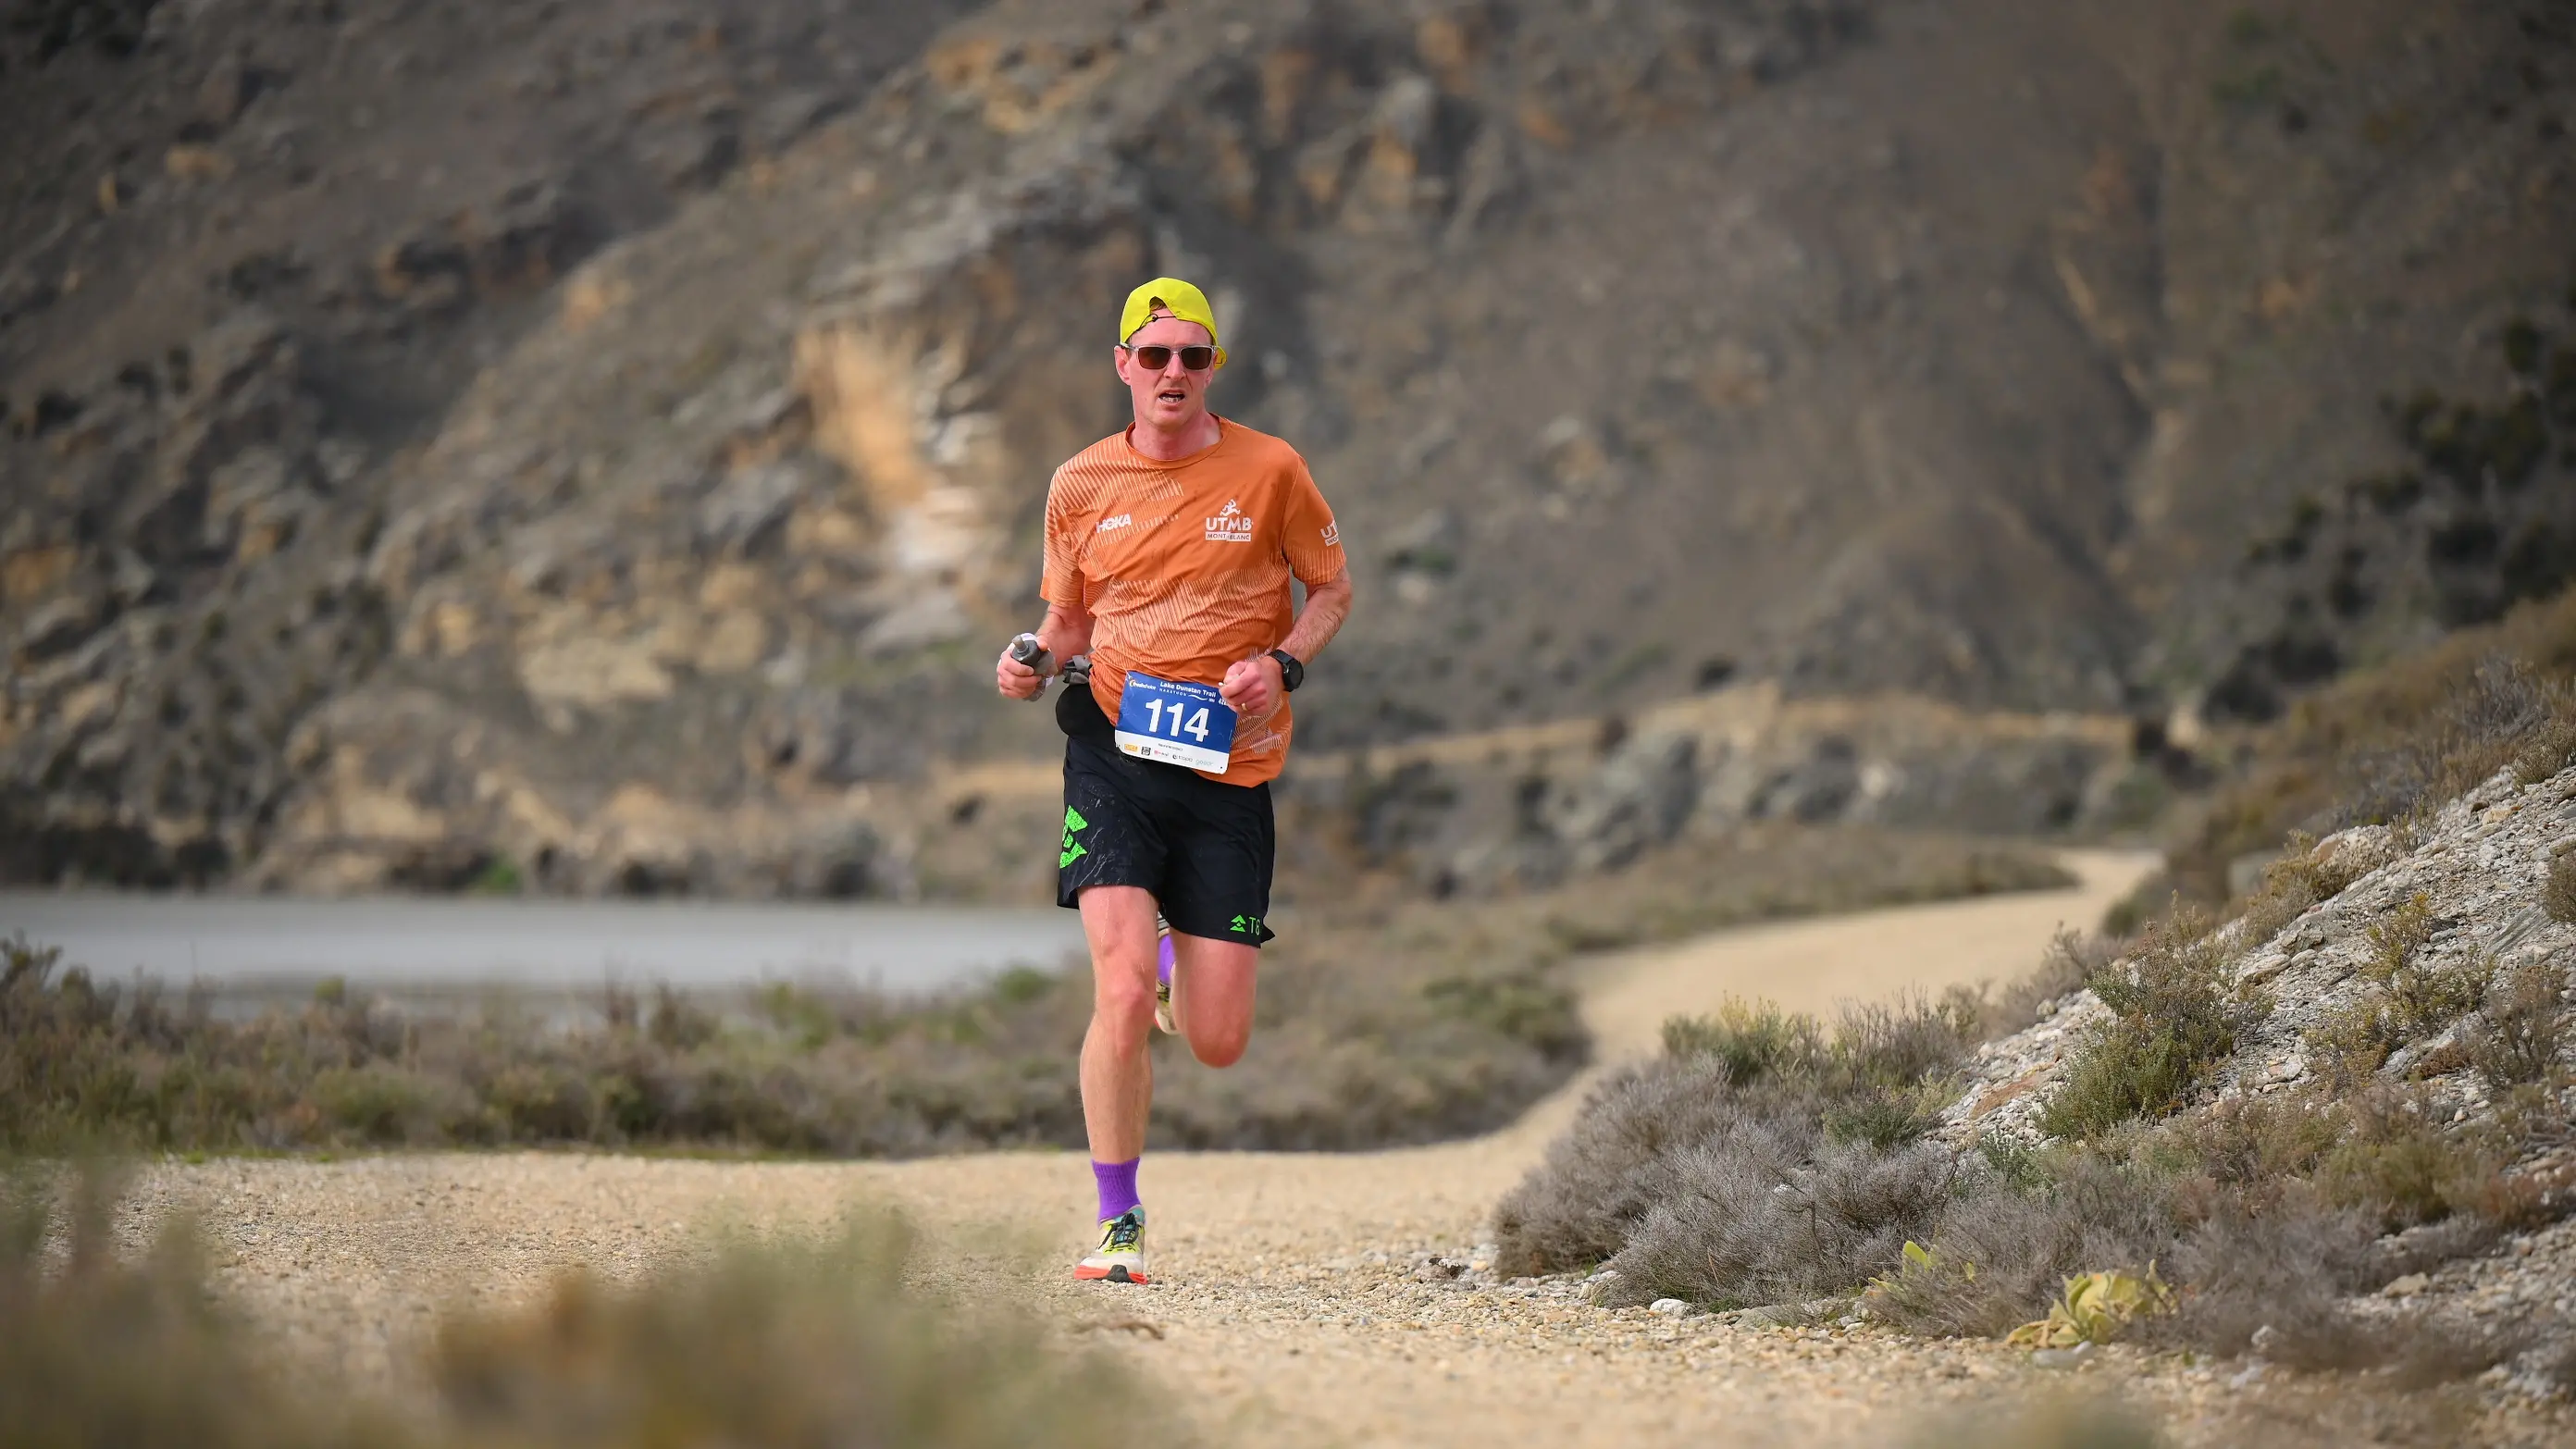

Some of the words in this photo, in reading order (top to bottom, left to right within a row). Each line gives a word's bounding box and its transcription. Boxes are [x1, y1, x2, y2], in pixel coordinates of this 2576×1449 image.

[1096, 514, 1133, 533] HOKA
[1206, 515, 1252, 531] UTMB
[1159, 681, 1175, 689] Lake
[1176, 684, 1202, 695] Dunstan
[1203, 689, 1217, 698] Trail
[1146, 698, 1209, 742] 114
[1248, 916, 1261, 936] T8
